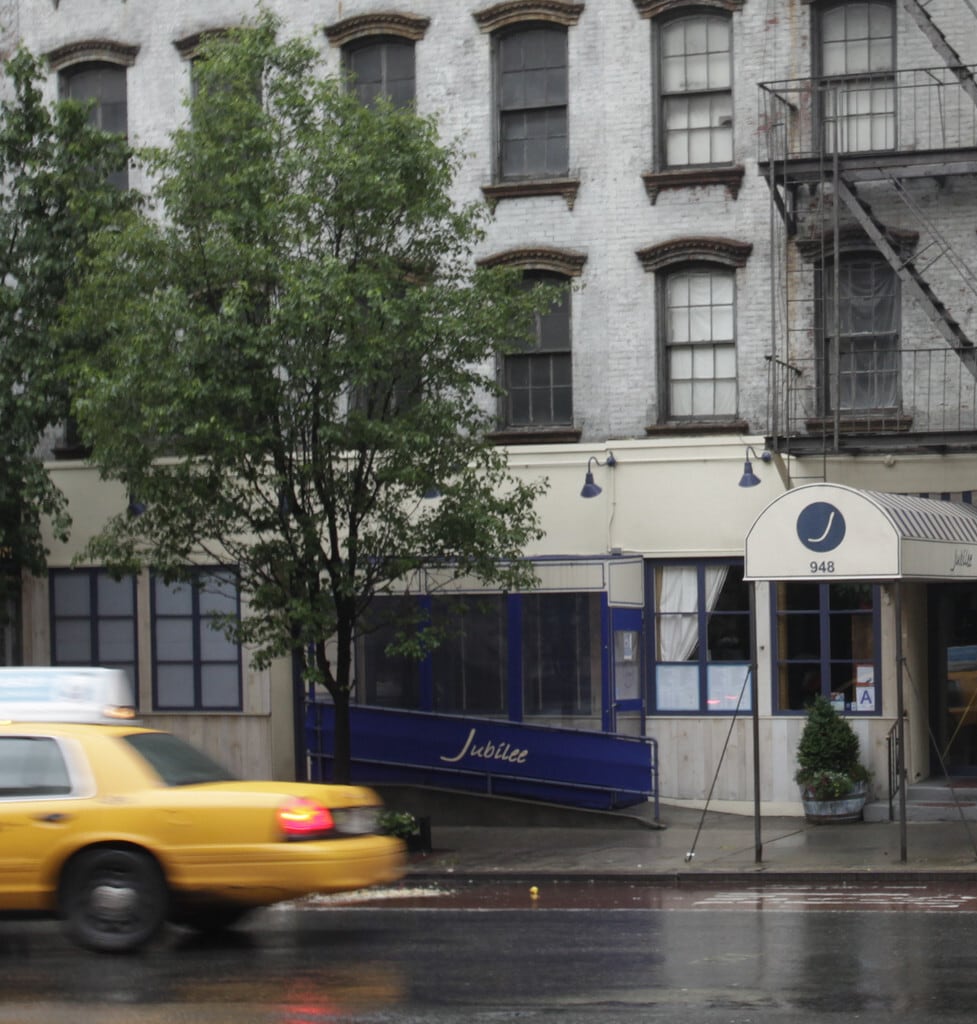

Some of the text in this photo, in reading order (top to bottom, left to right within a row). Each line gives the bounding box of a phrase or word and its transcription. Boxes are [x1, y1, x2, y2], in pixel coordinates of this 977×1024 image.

[808, 511, 834, 542] J
[809, 561, 835, 574] 948
[860, 690, 872, 704] A
[440, 728, 529, 764] Jubilee
